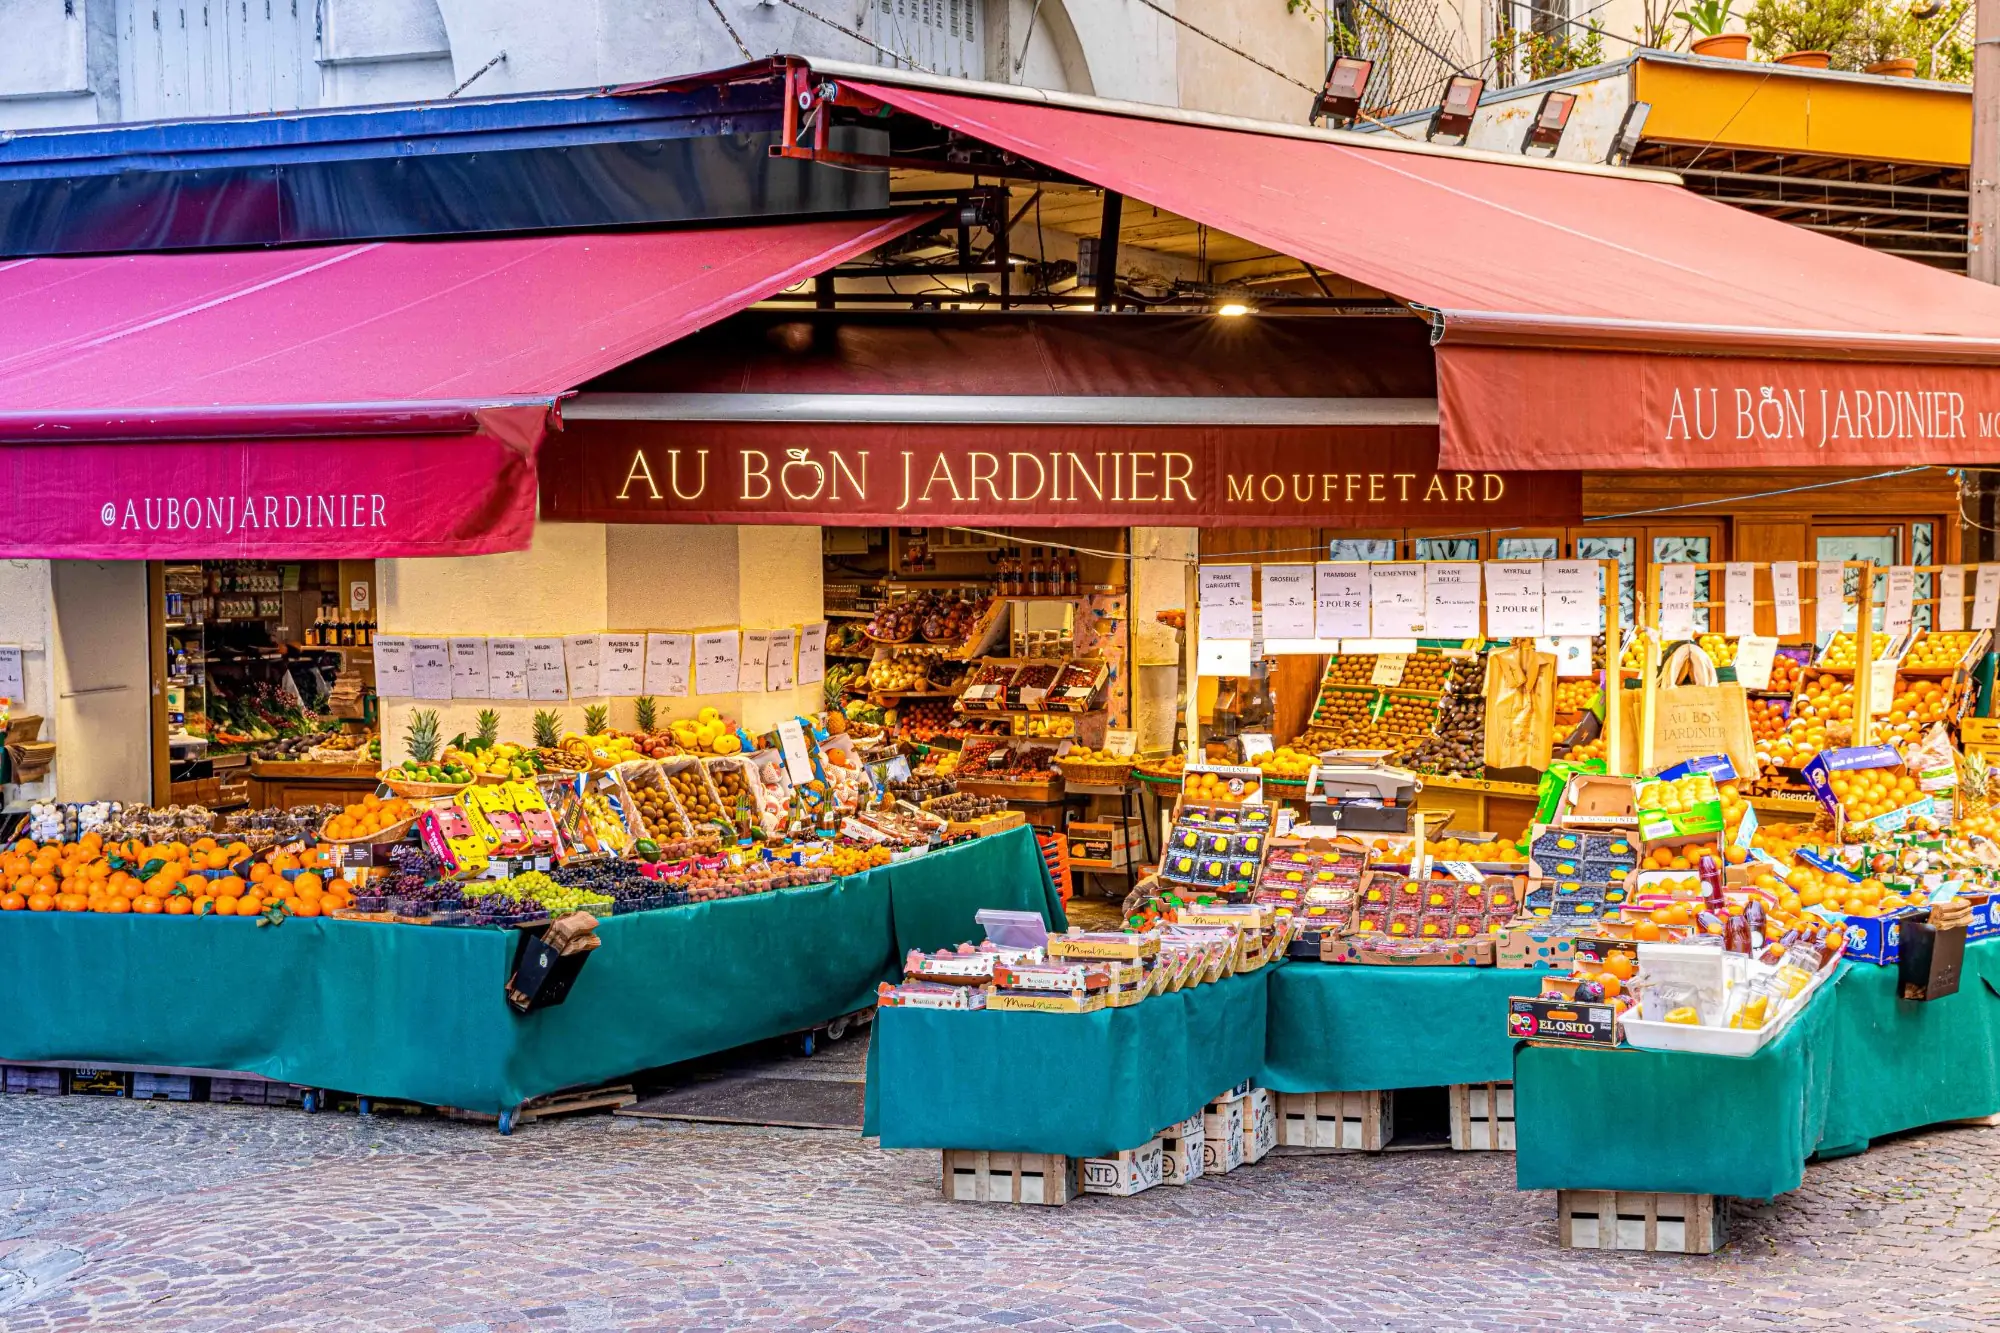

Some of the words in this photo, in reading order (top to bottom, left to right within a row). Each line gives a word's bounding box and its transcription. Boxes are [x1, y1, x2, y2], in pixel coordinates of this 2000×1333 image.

[1665, 387, 1718, 440] AU
[1735, 386, 1805, 439] BON
[1818, 389, 1966, 448] JARDINIER
[616, 449, 709, 500] AU
[740, 448, 869, 501] BON
[897, 451, 1197, 510] JARDINIER
[1227, 473, 1505, 502] MOUFFETARD
[101, 494, 387, 534] @AUBONJARDINIER
[1320, 600, 1324, 608] 2
[1326, 600, 1351, 608] POUR
[1495, 605, 1500, 613] 2
[1502, 605, 1528, 613] POUR
[1530, 605, 1539, 613] 6€
[1664, 727, 1726, 741] JARDINIER
[1771, 789, 1816, 802] Plasencia
[1539, 1019, 1556, 1030] EL
[1556, 1021, 1595, 1034] OSITO
